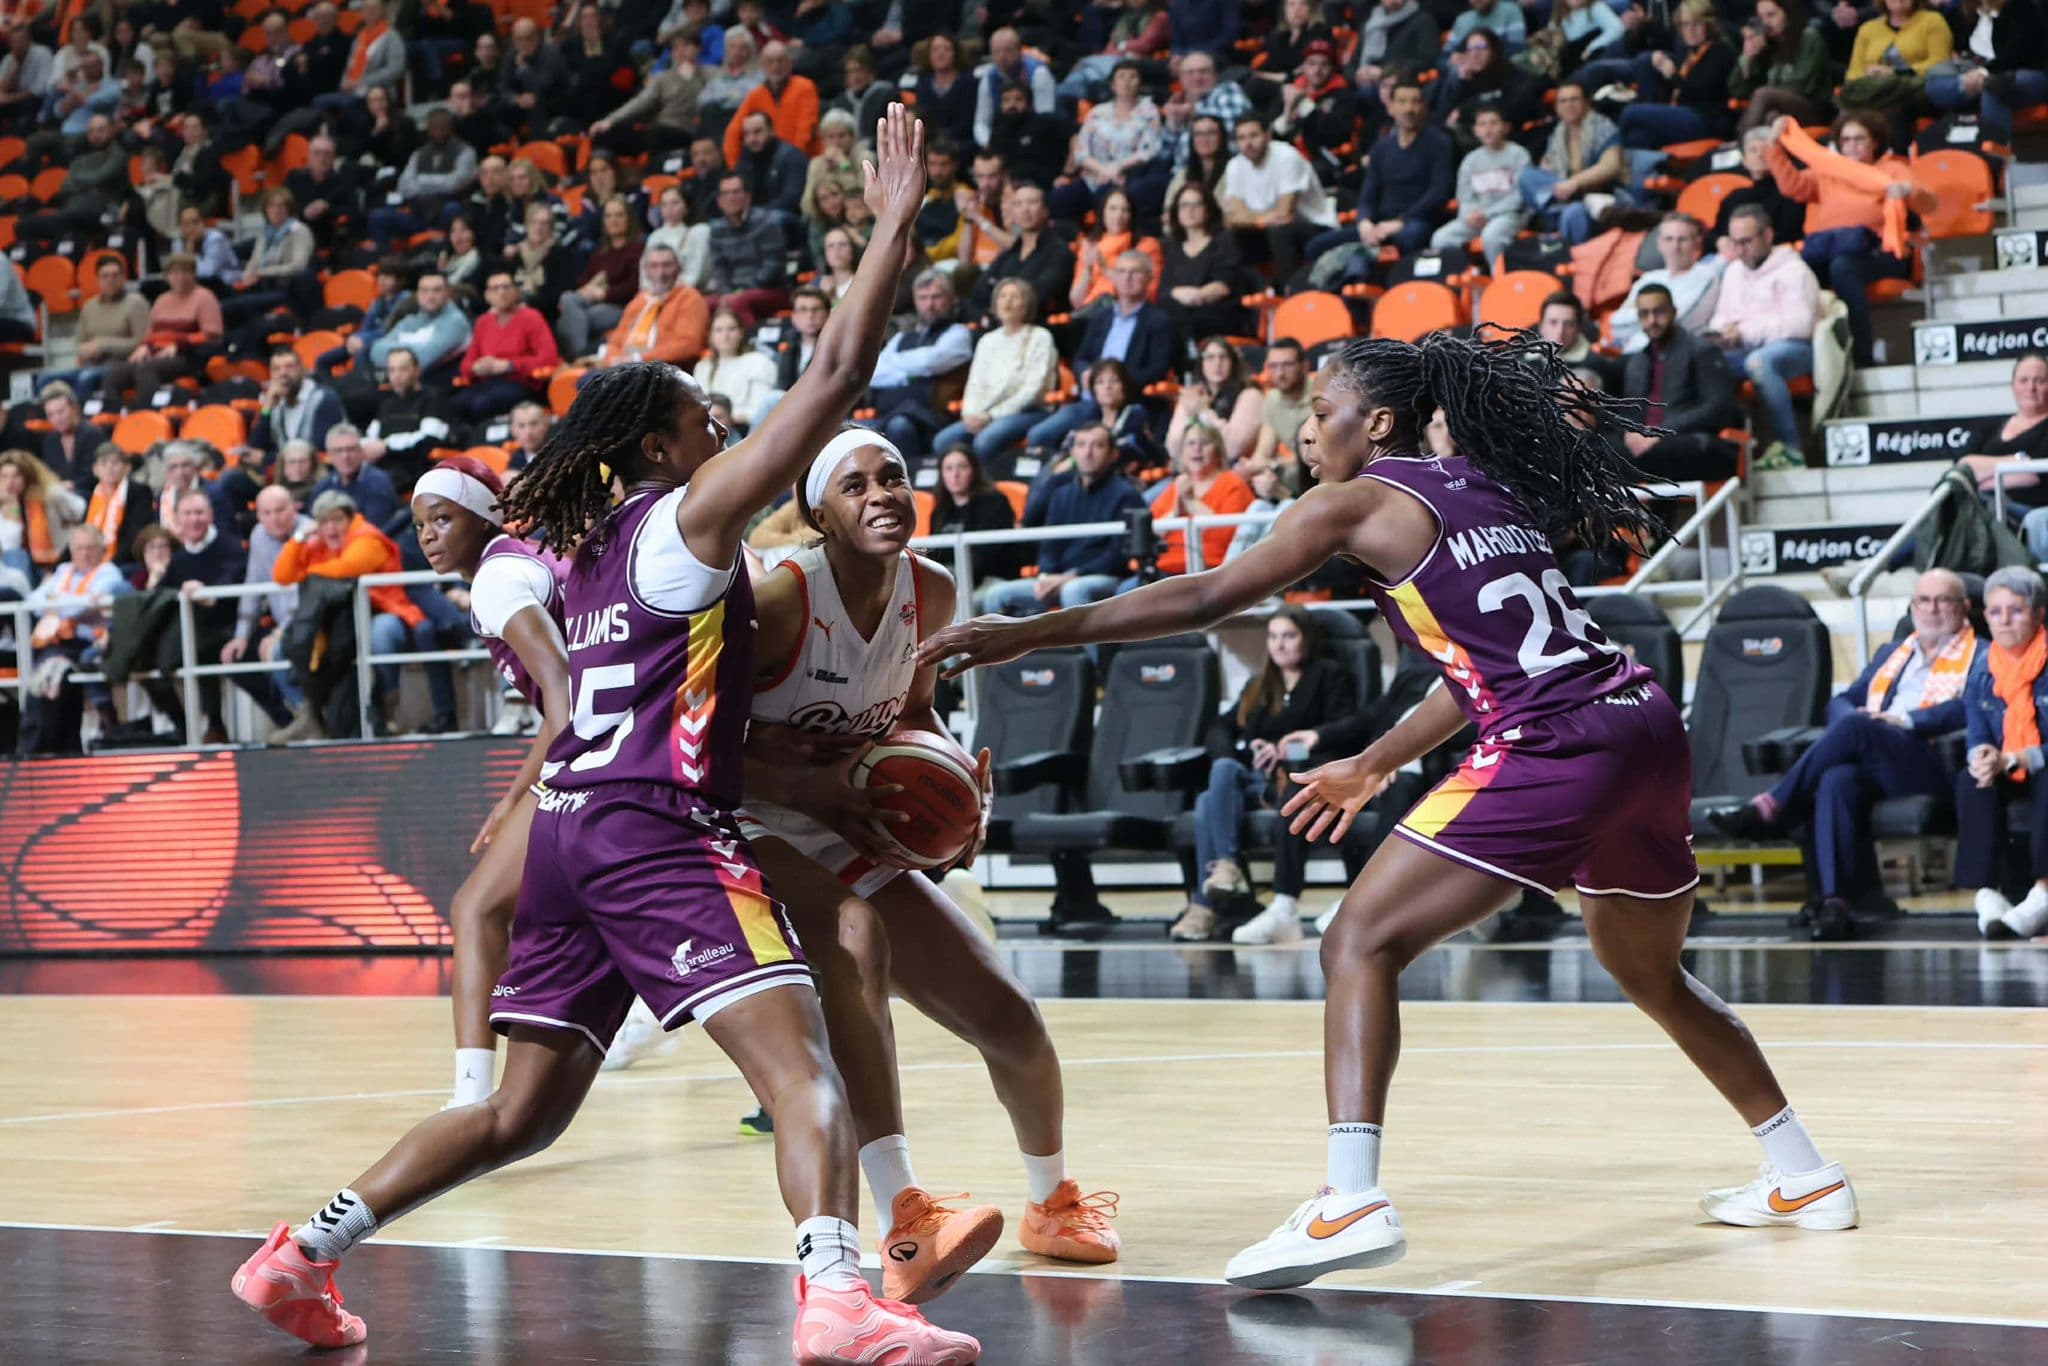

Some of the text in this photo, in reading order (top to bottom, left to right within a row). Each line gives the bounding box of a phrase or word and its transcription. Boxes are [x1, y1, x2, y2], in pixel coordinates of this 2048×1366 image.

[1963, 327, 2048, 356] Région C
[1876, 431, 1943, 455] Région
[1782, 538, 1852, 564] Région
[568, 663, 636, 772] 5
